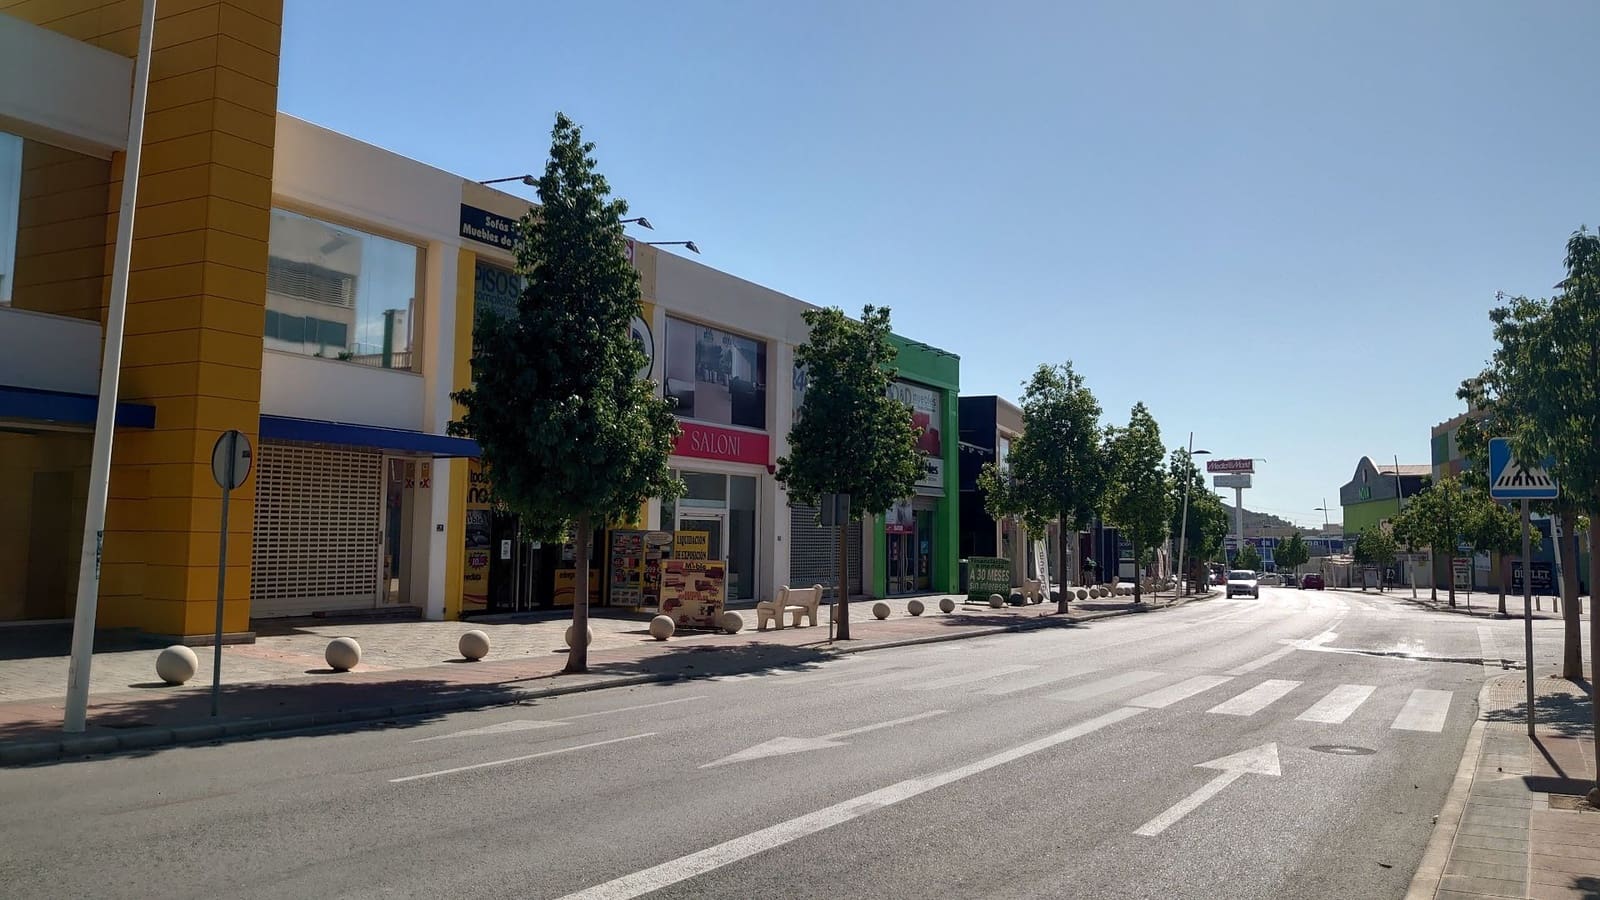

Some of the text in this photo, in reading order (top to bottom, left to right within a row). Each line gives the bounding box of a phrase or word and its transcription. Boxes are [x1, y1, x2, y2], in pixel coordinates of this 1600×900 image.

[462, 222, 499, 243] Muebles
[500, 234, 512, 247] de
[485, 215, 509, 233] Sofás
[691, 430, 740, 457] SALONI
[970, 569, 1010, 582] A 30 MESES
